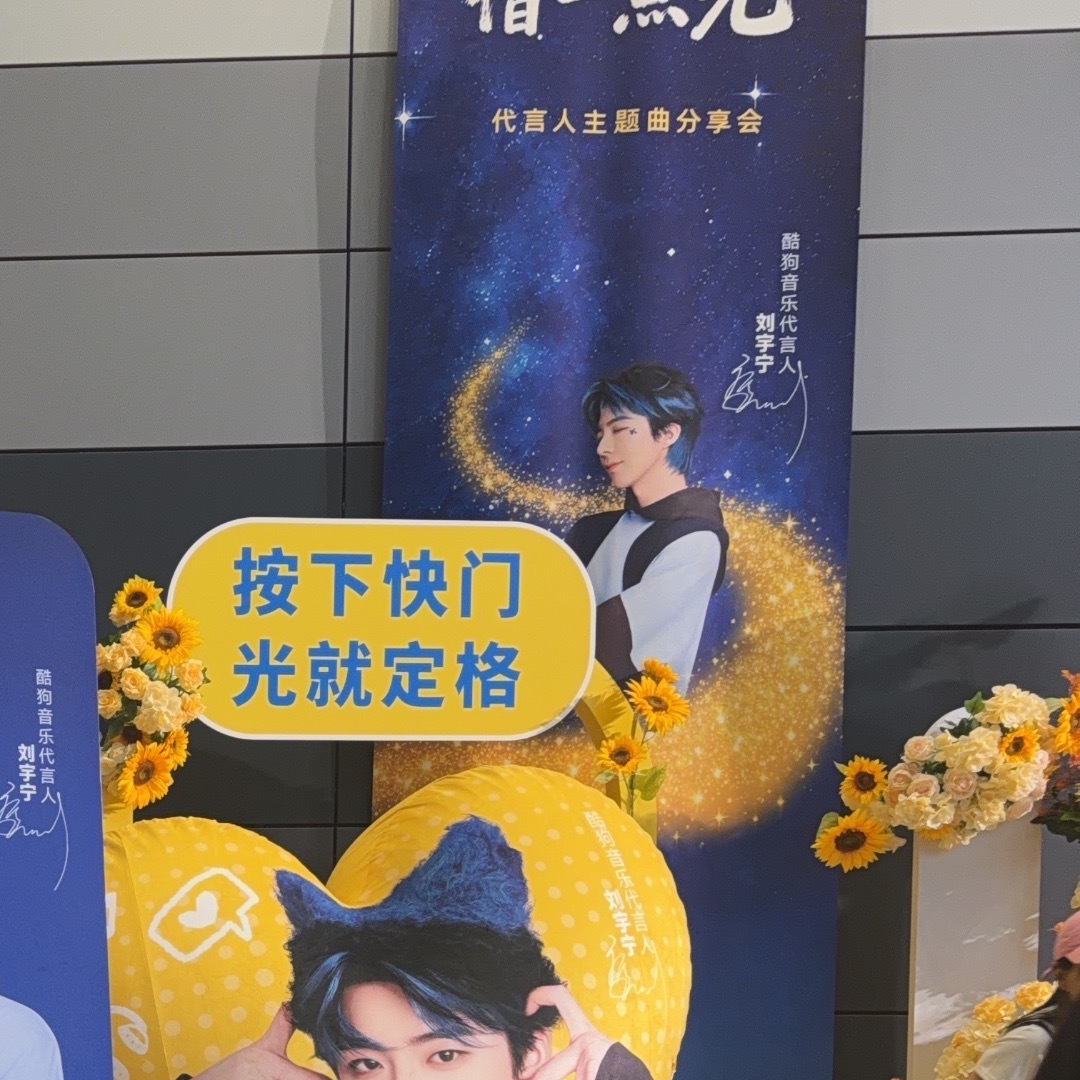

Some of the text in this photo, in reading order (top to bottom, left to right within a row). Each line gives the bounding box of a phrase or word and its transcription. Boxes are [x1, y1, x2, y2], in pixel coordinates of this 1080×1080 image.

[491, 107, 764, 135] 代言人主题曲分享会
[778, 231, 801, 375] 酷狗音乐代言人
[754, 312, 775, 374] 刘宇宁
[232, 546, 521, 618] 按下快门
[231, 638, 521, 709] 光就定格
[35, 668, 57, 804] 酷狗音乐代言人
[17, 743, 37, 802] 刘宇宁
[583, 809, 655, 956] 酷狗音乐代言人
[603, 888, 637, 957] 刘宇宁
